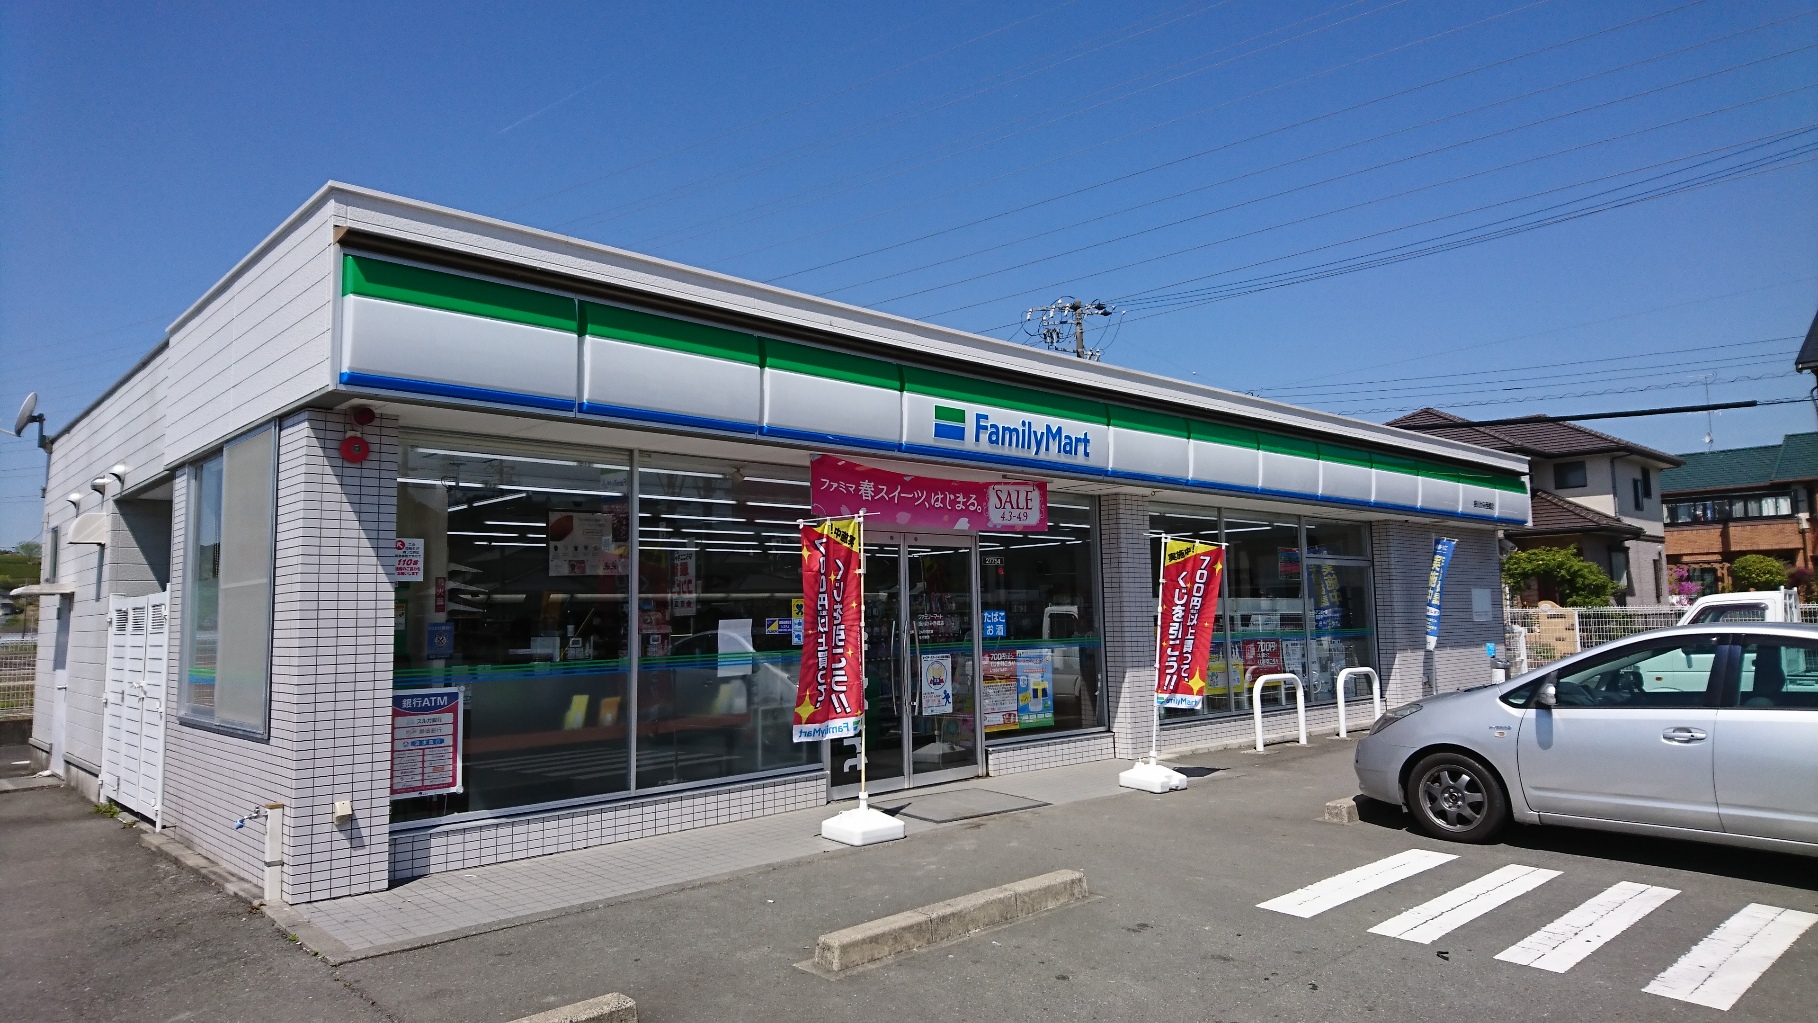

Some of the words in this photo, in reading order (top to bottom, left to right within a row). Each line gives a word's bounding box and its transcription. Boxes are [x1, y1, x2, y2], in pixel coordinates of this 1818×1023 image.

[974, 412, 1090, 457] FamilyMart
[820, 478, 855, 495] ファミマ
[858, 479, 982, 513] 春スイーツ、はじまる。
[993, 489, 1034, 510] SALE
[1000, 511, 1028, 522] 4.3-4.9
[983, 611, 1005, 623] たばこ
[986, 624, 1004, 636] お酒
[402, 696, 448, 709] 銀行ATM
